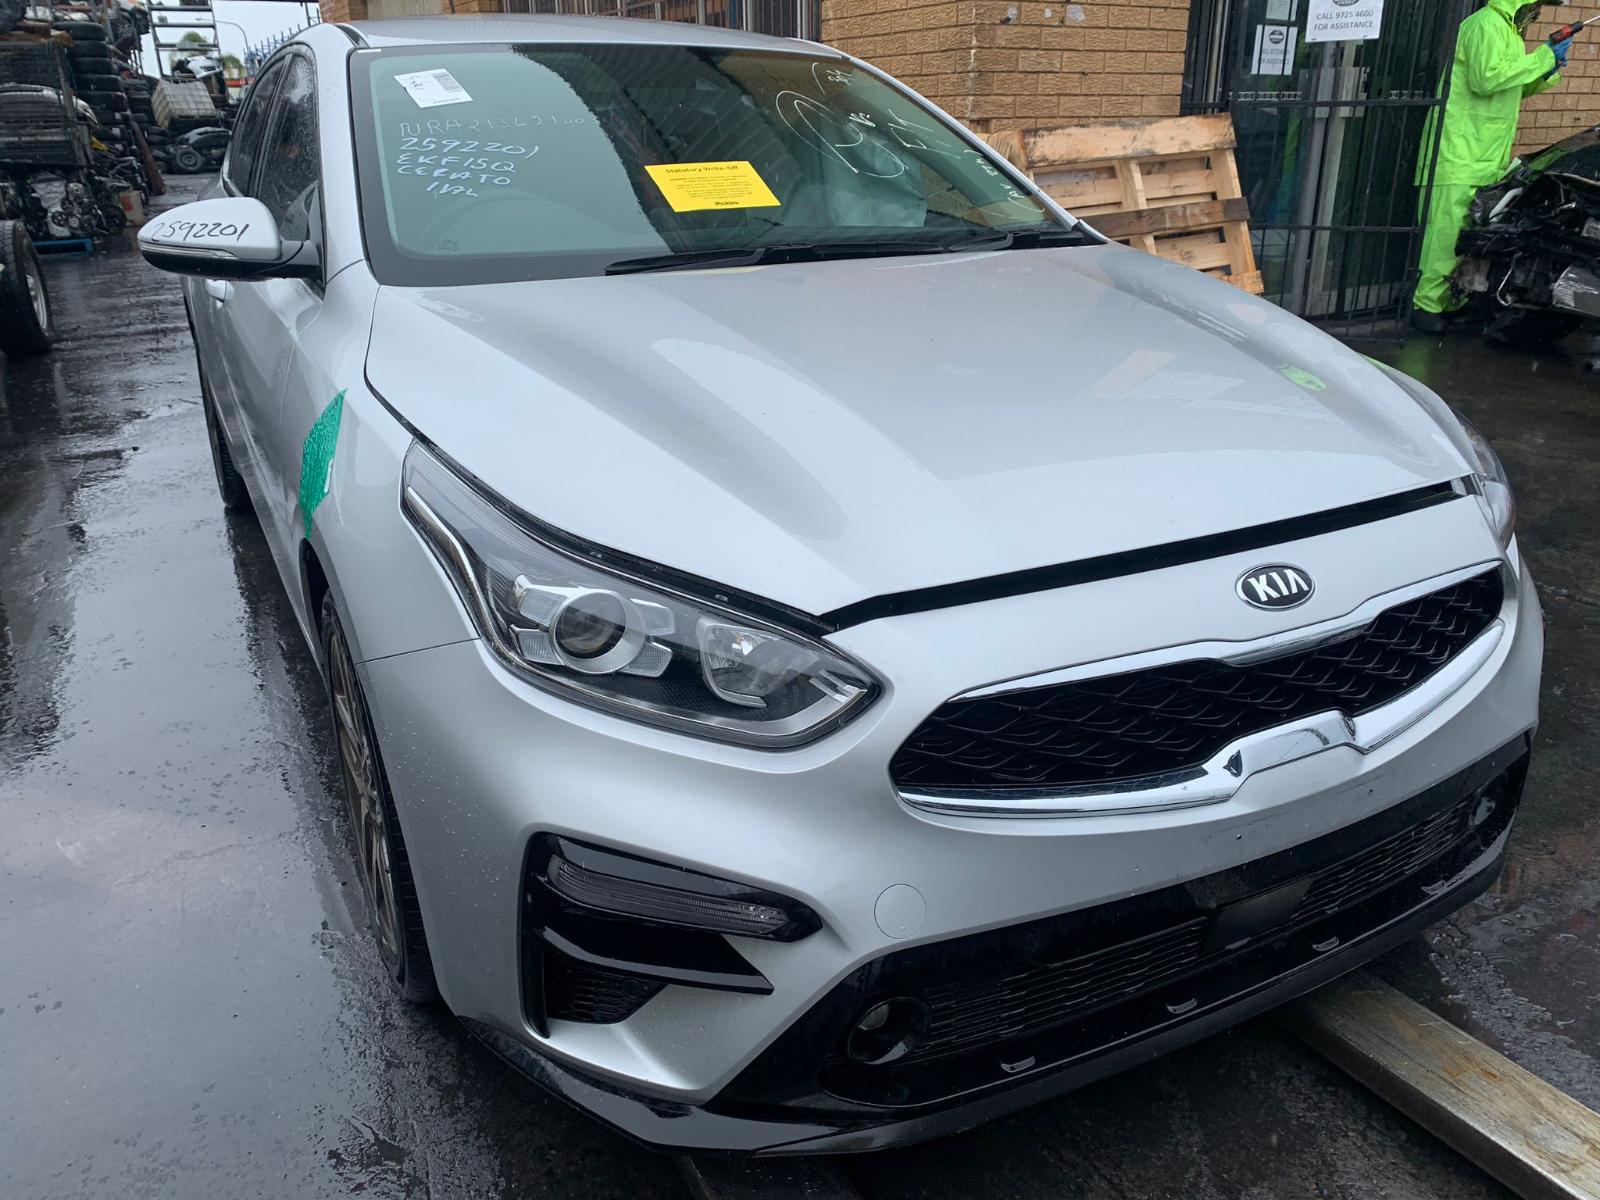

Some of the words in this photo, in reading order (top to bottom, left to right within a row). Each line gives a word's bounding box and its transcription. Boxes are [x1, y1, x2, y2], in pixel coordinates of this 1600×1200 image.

[1313, 22, 1329, 31] FOR
[1330, 20, 1374, 30] ASSISTANCE
[1316, 12, 1334, 20] CALL
[399, 138, 540, 159] 2592201
[151, 220, 250, 242] 2592201
[1247, 569, 1310, 602] KIA
